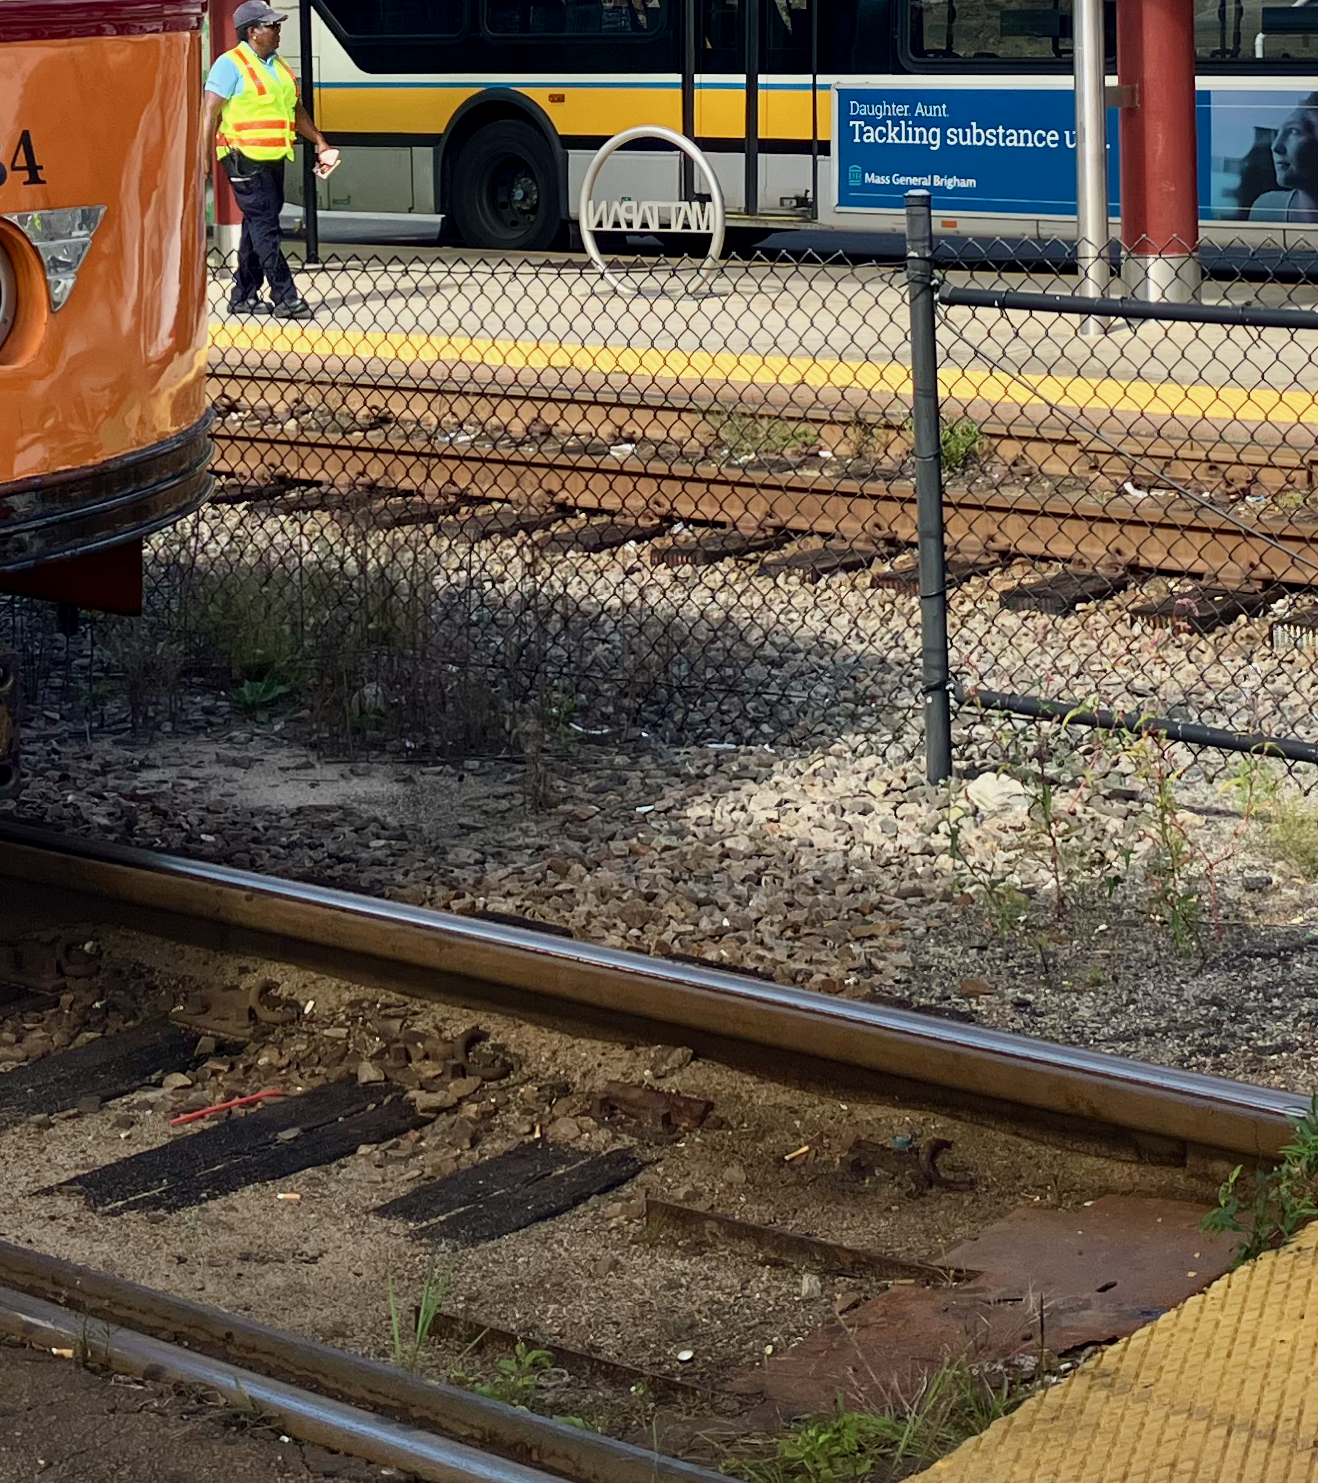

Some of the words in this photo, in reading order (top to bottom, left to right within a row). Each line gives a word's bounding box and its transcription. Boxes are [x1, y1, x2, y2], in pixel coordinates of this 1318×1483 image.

[849, 100, 912, 120] Daughter.
[914, 102, 950, 118] Aunt.
[849, 119, 941, 151] Tackling
[946, 121, 1060, 148] substance
[864, 172, 891, 186] Mass
[891, 173, 932, 187] General
[933, 174, 977, 190] Brigham
